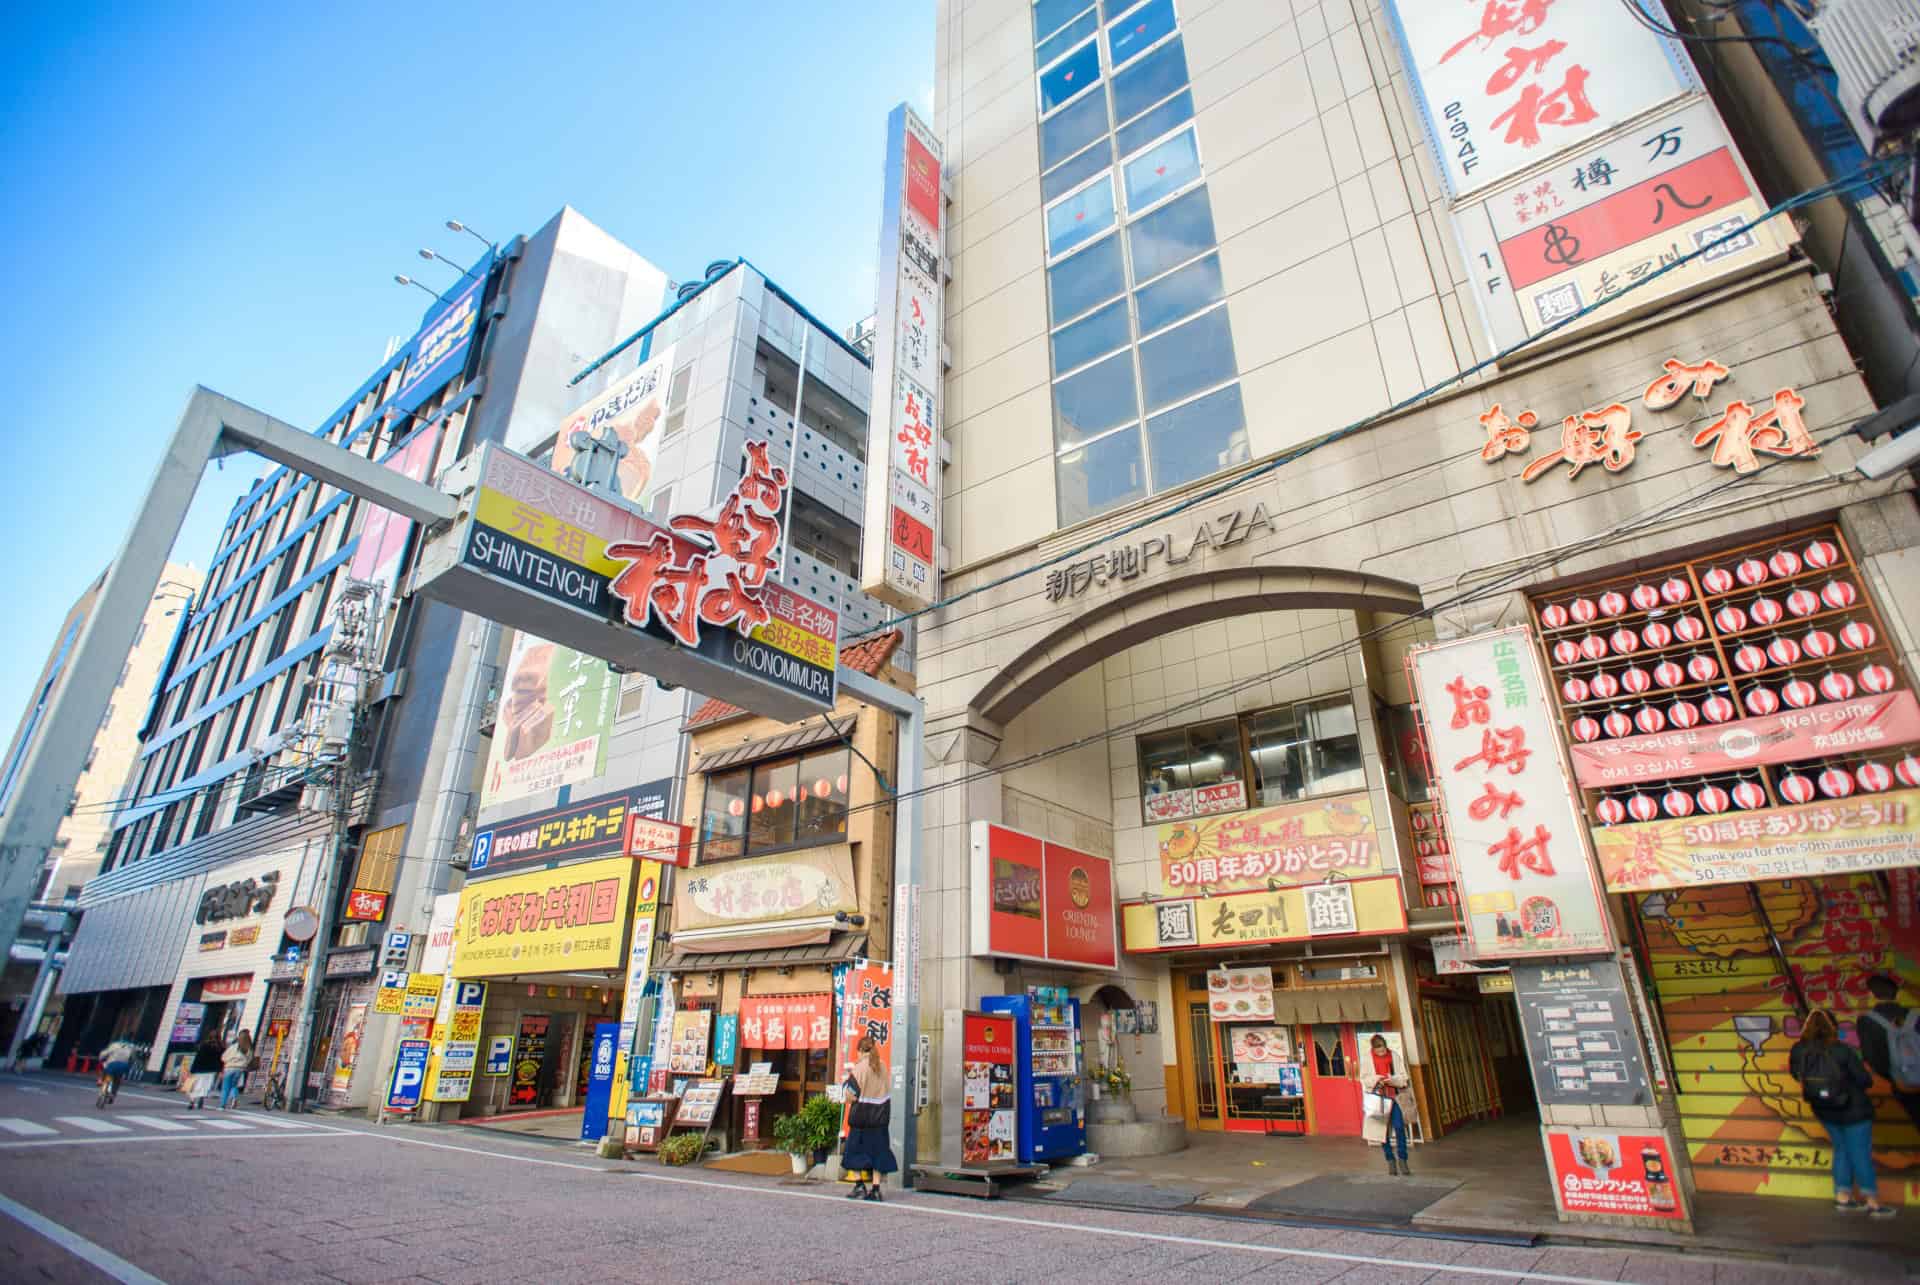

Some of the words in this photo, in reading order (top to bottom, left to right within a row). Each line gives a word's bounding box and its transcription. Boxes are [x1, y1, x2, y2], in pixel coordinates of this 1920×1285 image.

[1479, 359, 1823, 474] お好み村
[486, 456, 599, 533] 新天地
[507, 502, 588, 566] 元祖
[605, 440, 789, 648] お好み村
[471, 533, 599, 606] SHINTENCHI
[761, 623, 833, 668] お好み焼き
[734, 639, 830, 698] OKONOMIMURA
[1780, 702, 1876, 730] Welcome
[1444, 675, 1558, 881] お好み村
[1169, 841, 1370, 886] 50周年ありがとう!!
[1689, 851, 1724, 866] Thank
[1726, 849, 1752, 866] you
[1754, 846, 1771, 861] for
[1773, 845, 1797, 860] the
[1799, 840, 1834, 855] 50th
[1834, 831, 1914, 852] anniversary
[480, 878, 620, 938] お好み共和国
[1212, 896, 1288, 937] 老四川
[462, 983, 480, 1004] P
[487, 1038, 511, 1060] P
[743, 1014, 830, 1043] 村長の店
[393, 1067, 422, 1095] P
